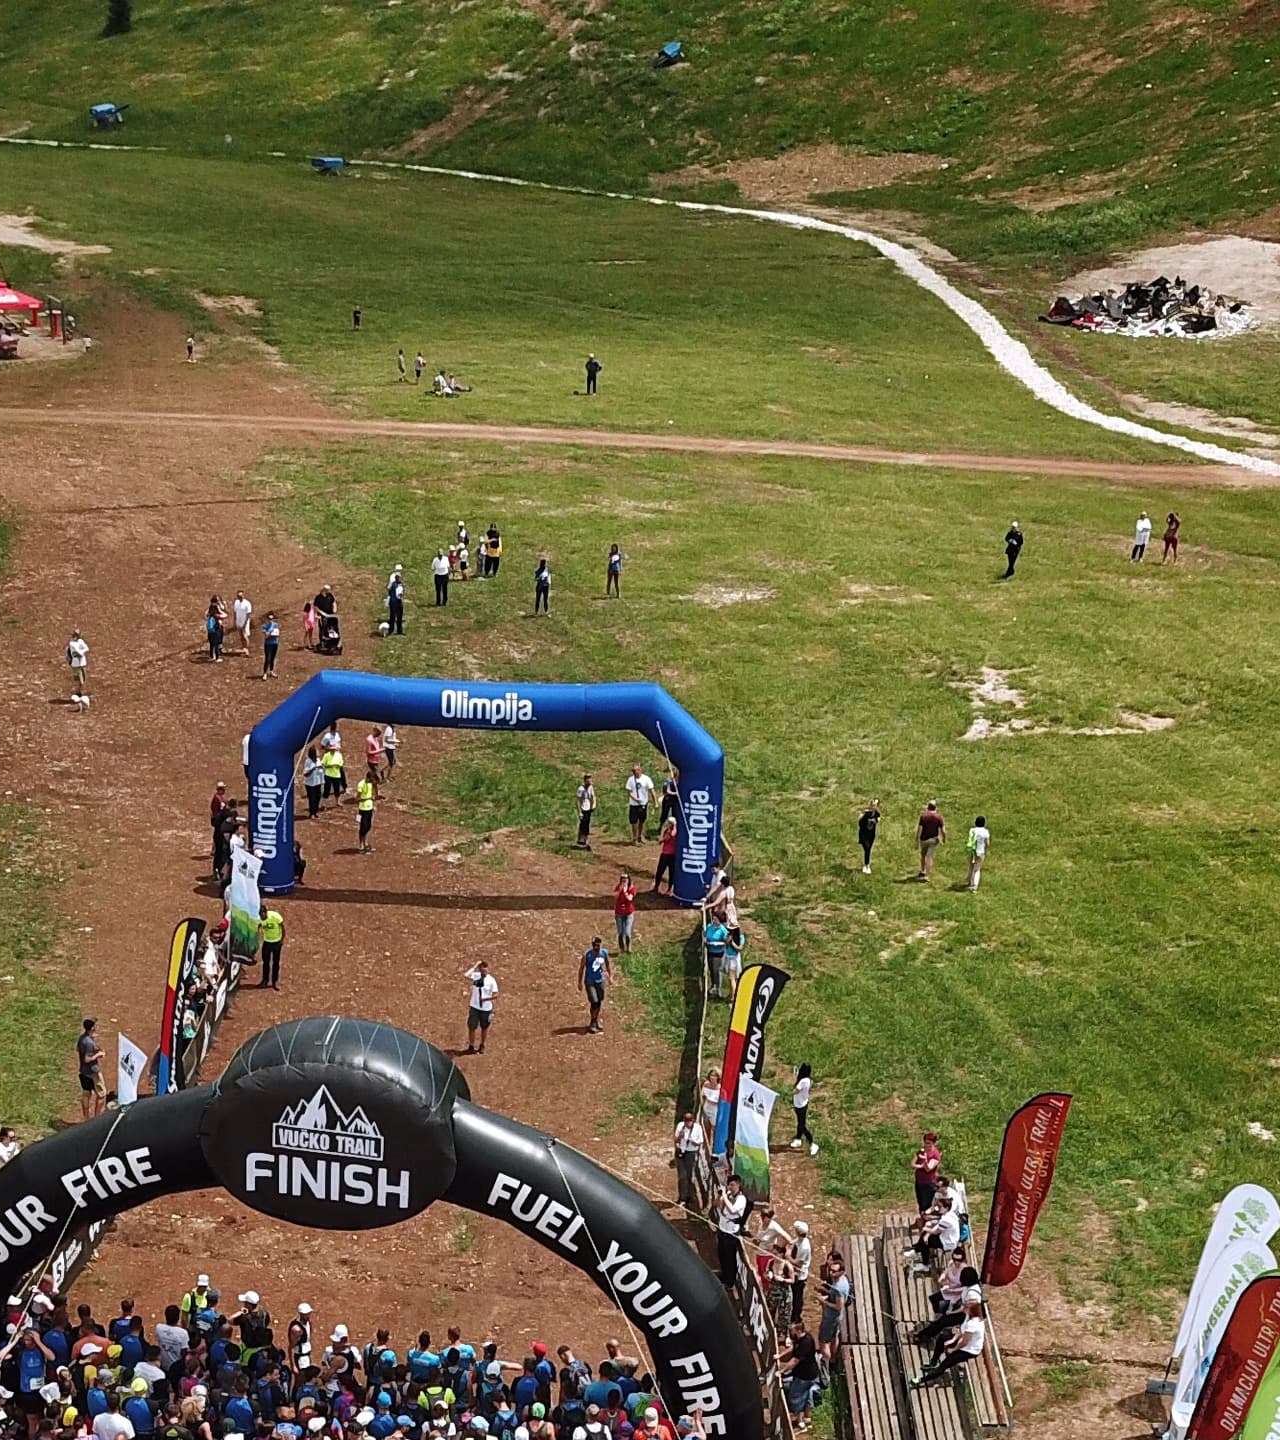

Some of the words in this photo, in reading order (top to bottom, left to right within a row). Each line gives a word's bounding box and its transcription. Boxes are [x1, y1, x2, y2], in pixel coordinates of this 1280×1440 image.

[441, 689, 533, 725] Olimpija
[252, 772, 282, 859] Olimpija
[682, 789, 714, 874] Olimpija
[278, 1128, 331, 1151] VUČKO
[336, 1135, 379, 1157] TRAIL
[1030, 1108, 1053, 1145] TRAIL
[61, 1146, 161, 1209] FIRE
[245, 1152, 411, 1209] FINISH
[487, 1172, 585, 1253] FUEL
[596, 1239, 688, 1338] YOUR
[669, 1351, 727, 1436] FIRE
[1219, 1359, 1263, 1434] DALMACIJA
